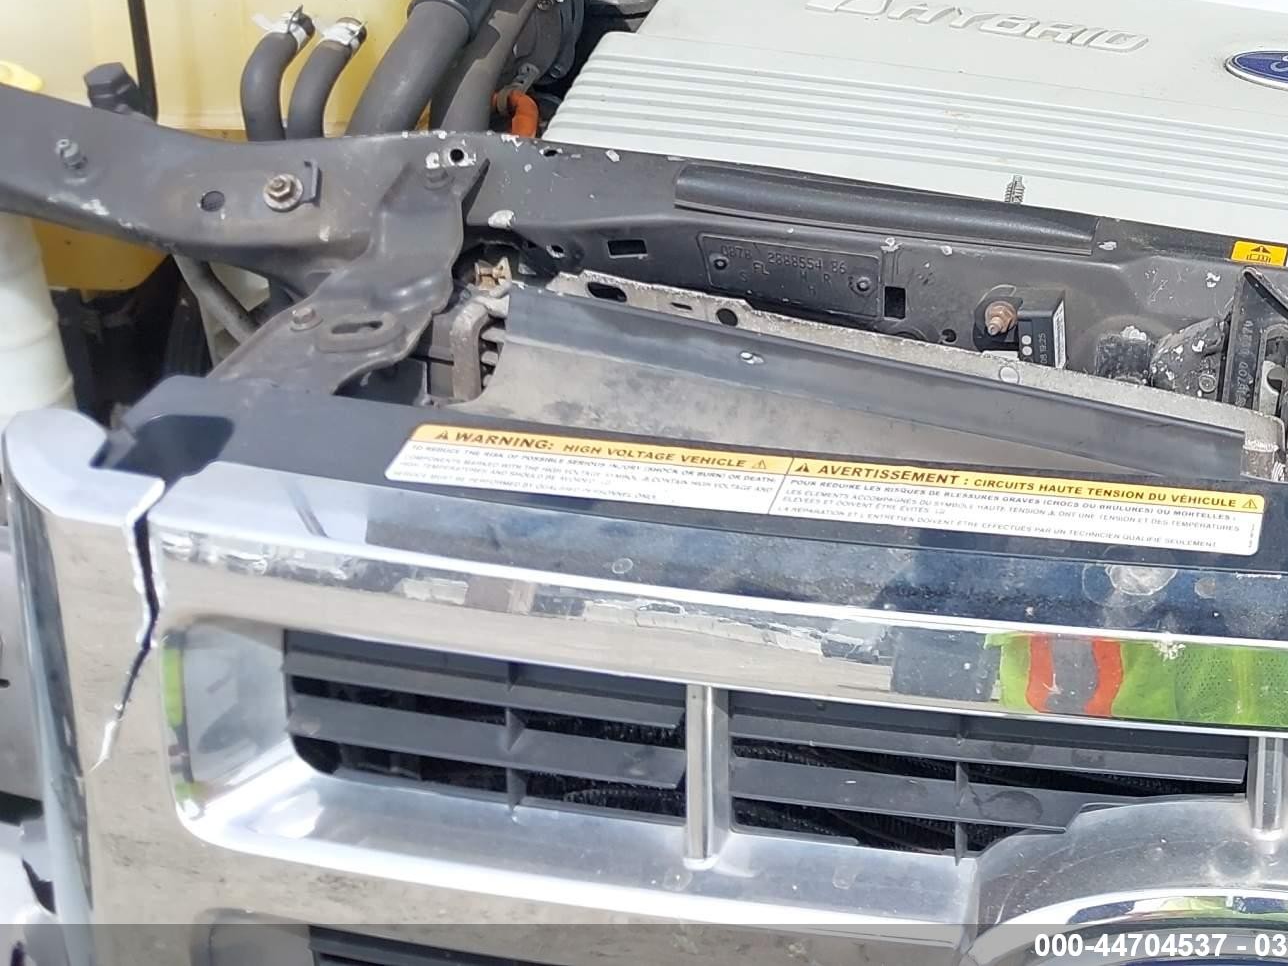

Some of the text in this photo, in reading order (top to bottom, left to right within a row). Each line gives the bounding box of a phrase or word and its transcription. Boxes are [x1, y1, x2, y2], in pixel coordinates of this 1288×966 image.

[886, 2, 1149, 53] HYBRID
[455, 431, 746, 468] WARNING: HIGH VOLTAGE VEHICLE
[817, 463, 960, 485] AVERTISSEMENT
[973, 477, 1033, 491] CIRCUITS
[1039, 483, 1082, 494] HAUTE
[1088, 486, 1144, 500] TENSION
[1148, 491, 1166, 502] DU
